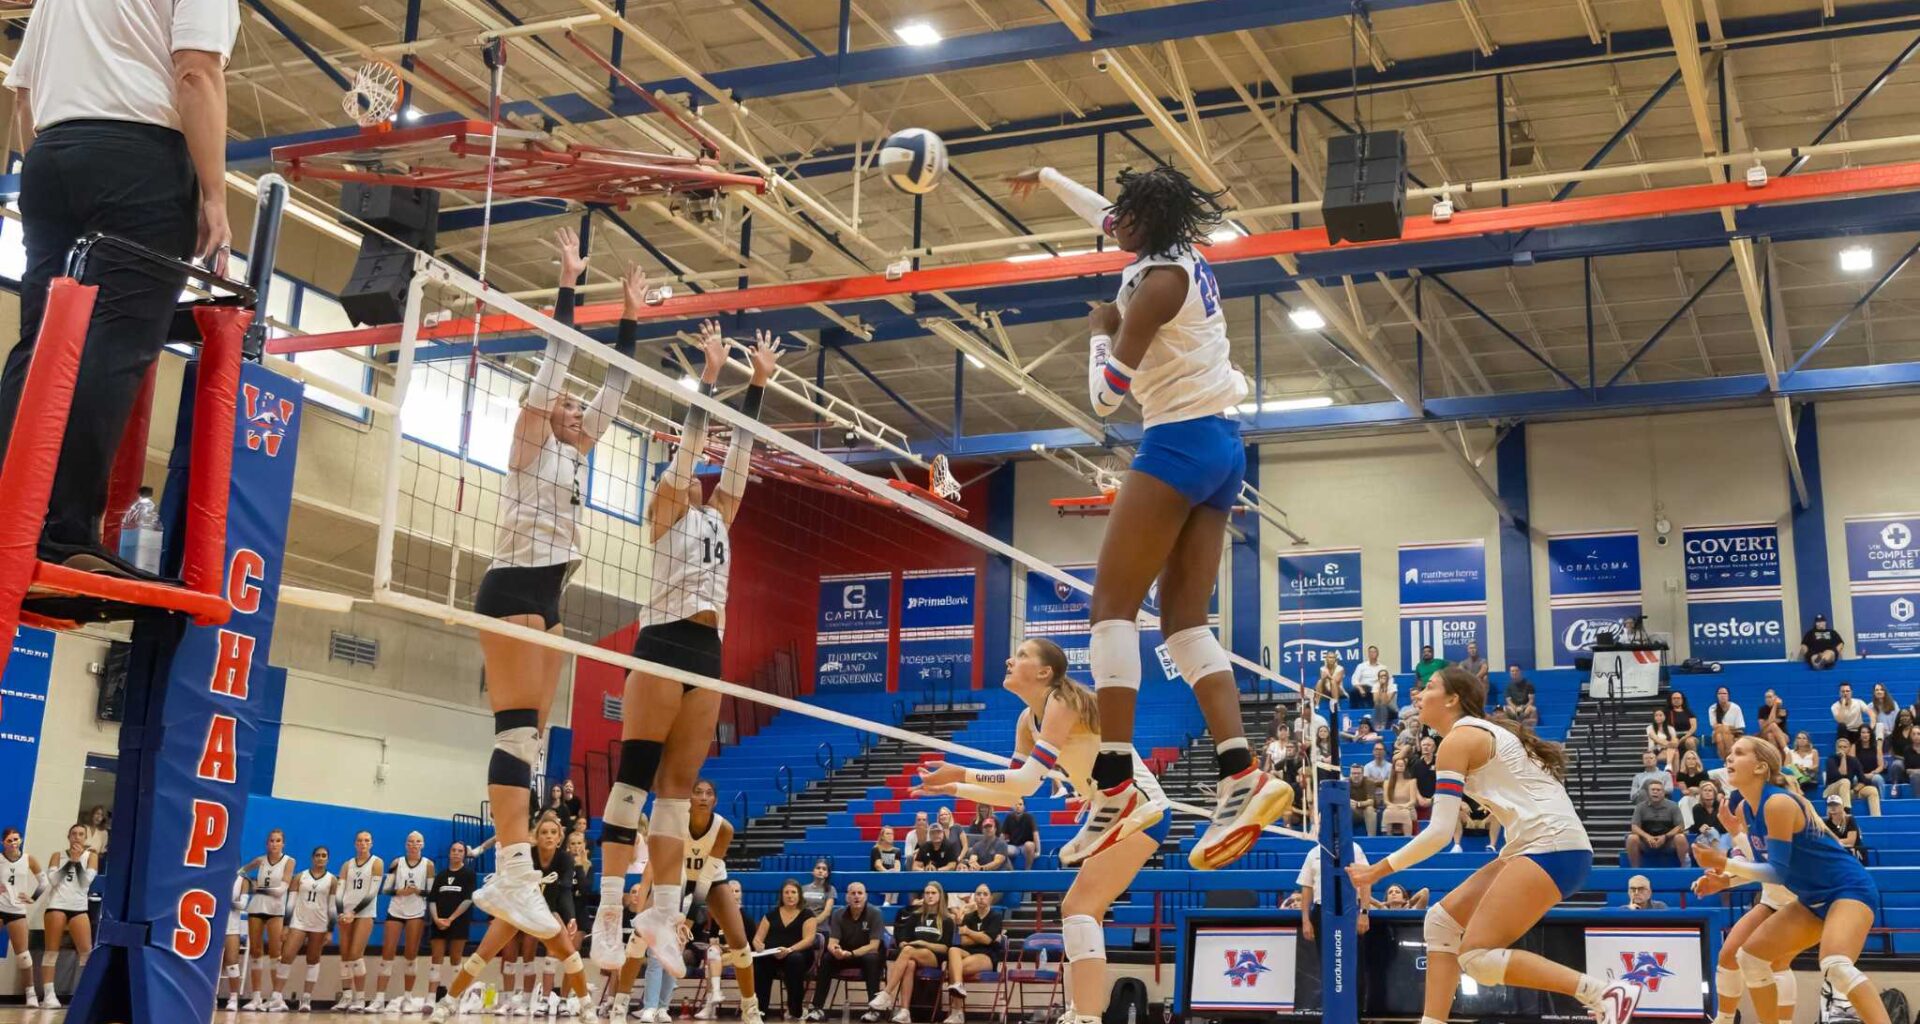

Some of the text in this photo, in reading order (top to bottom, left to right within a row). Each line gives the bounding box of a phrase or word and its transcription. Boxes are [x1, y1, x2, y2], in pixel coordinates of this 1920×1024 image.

[1685, 535, 1776, 554] COVERT
[703, 537, 725, 565] 14
[1868, 549, 1920, 560] COMPLET
[1687, 552, 1776, 565] AUTO GROUP
[1882, 559, 1914, 570] CARE
[1421, 570, 1455, 579] matthew
[825, 609, 883, 621] CAPITAL
[1443, 621, 1476, 631] CORD
[1693, 617, 1780, 638] restore
[828, 651, 878, 662] THOMPSON
[839, 663, 865, 673] LAND
[820, 673, 883, 685] ENGINEERING
[172, 548, 263, 960] CHAPS
[686, 857, 704, 870] 10
[8, 875, 15, 886] 4
[353, 879, 363, 891] 13
[307, 890, 317, 903] 11
